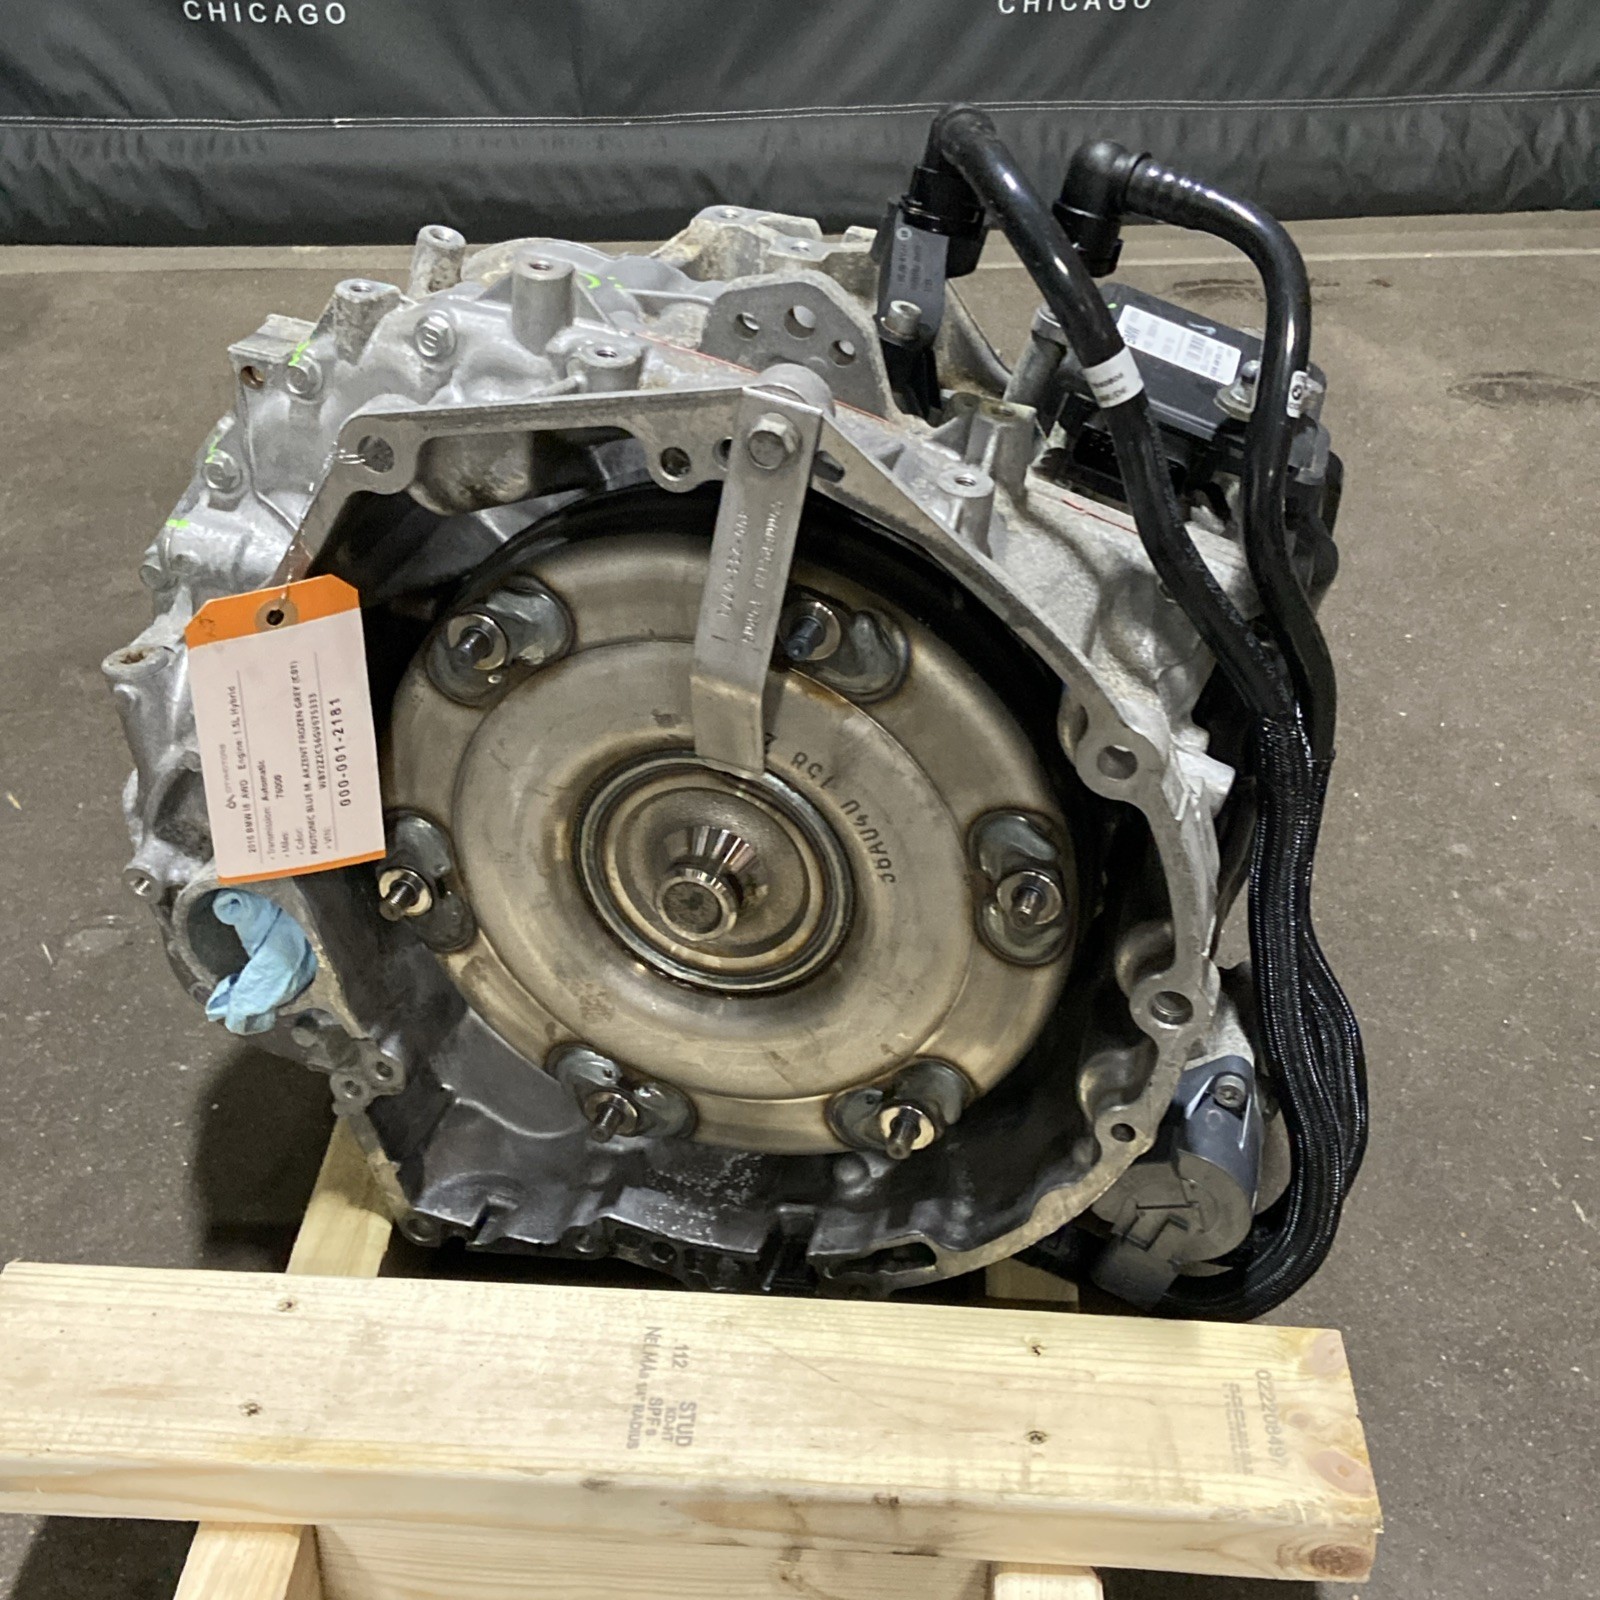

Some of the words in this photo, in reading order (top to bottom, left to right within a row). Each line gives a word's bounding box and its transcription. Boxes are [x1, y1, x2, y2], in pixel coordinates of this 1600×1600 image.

[183, 0, 347, 25] CHICAGO
[227, 686, 240, 715] Hybrid
[292, 686, 302, 709] GREY
[295, 710, 307, 744] FROZEN
[236, 738, 246, 770] Engine:
[329, 698, 351, 807] 000-001-2181
[240, 779, 250, 799] AWD
[257, 759, 270, 801] Automatic
[304, 793, 314, 813] BLUE
[243, 813, 254, 833] BMW
[264, 806, 276, 854] Transmission:
[672, 1344, 691, 1369] 112
[627, 1404, 646, 1450] RADIUS
[662, 1407, 677, 1443] KD-HT
[676, 1401, 697, 1447] STUD
